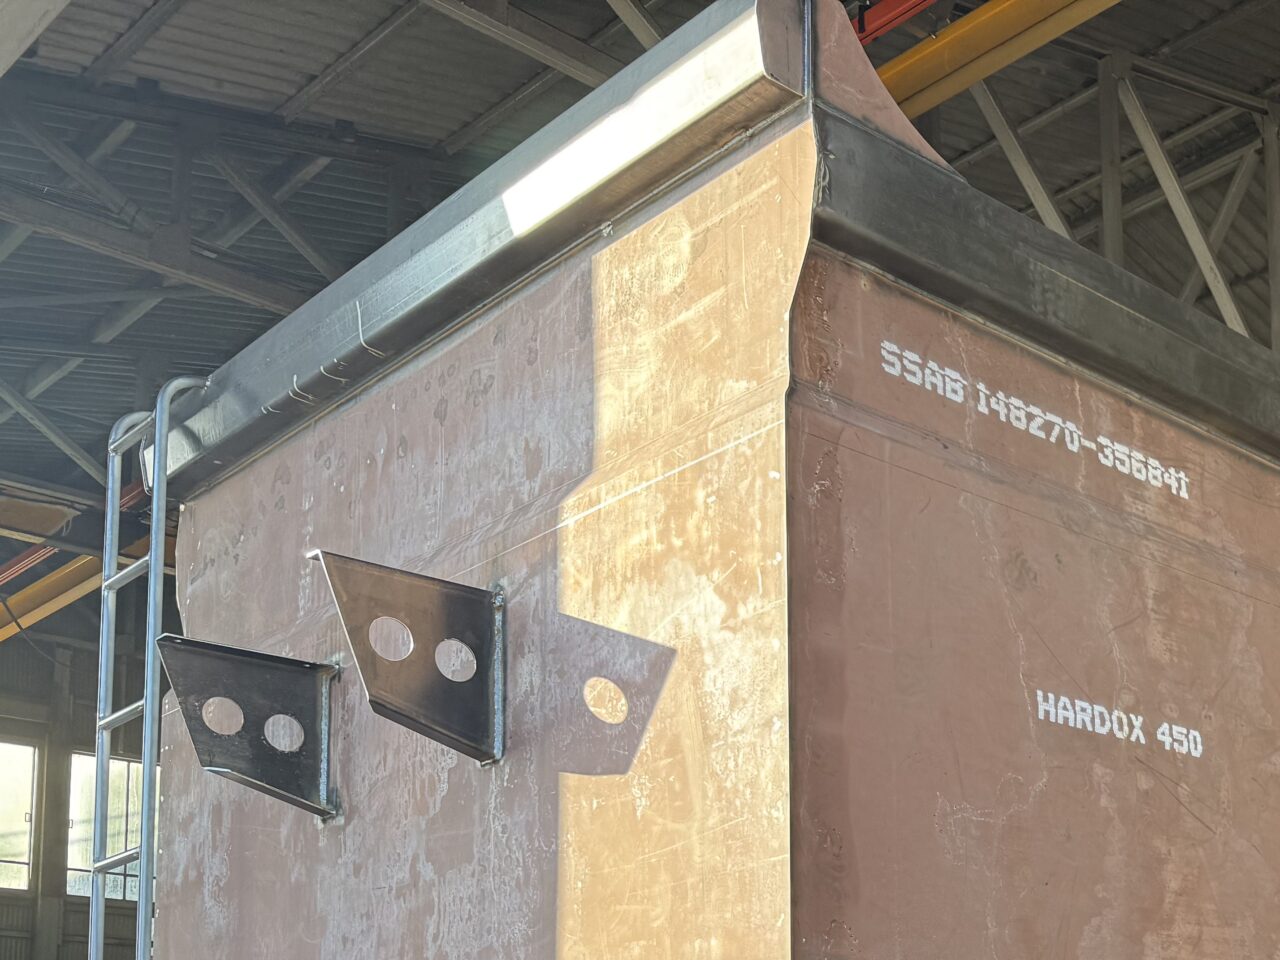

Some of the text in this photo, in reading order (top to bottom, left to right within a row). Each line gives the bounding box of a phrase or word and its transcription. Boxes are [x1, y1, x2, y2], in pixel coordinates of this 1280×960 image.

[880, 340, 1189, 499] SSAB 148270-356841
[1036, 689, 1204, 758] HARDOX 450
